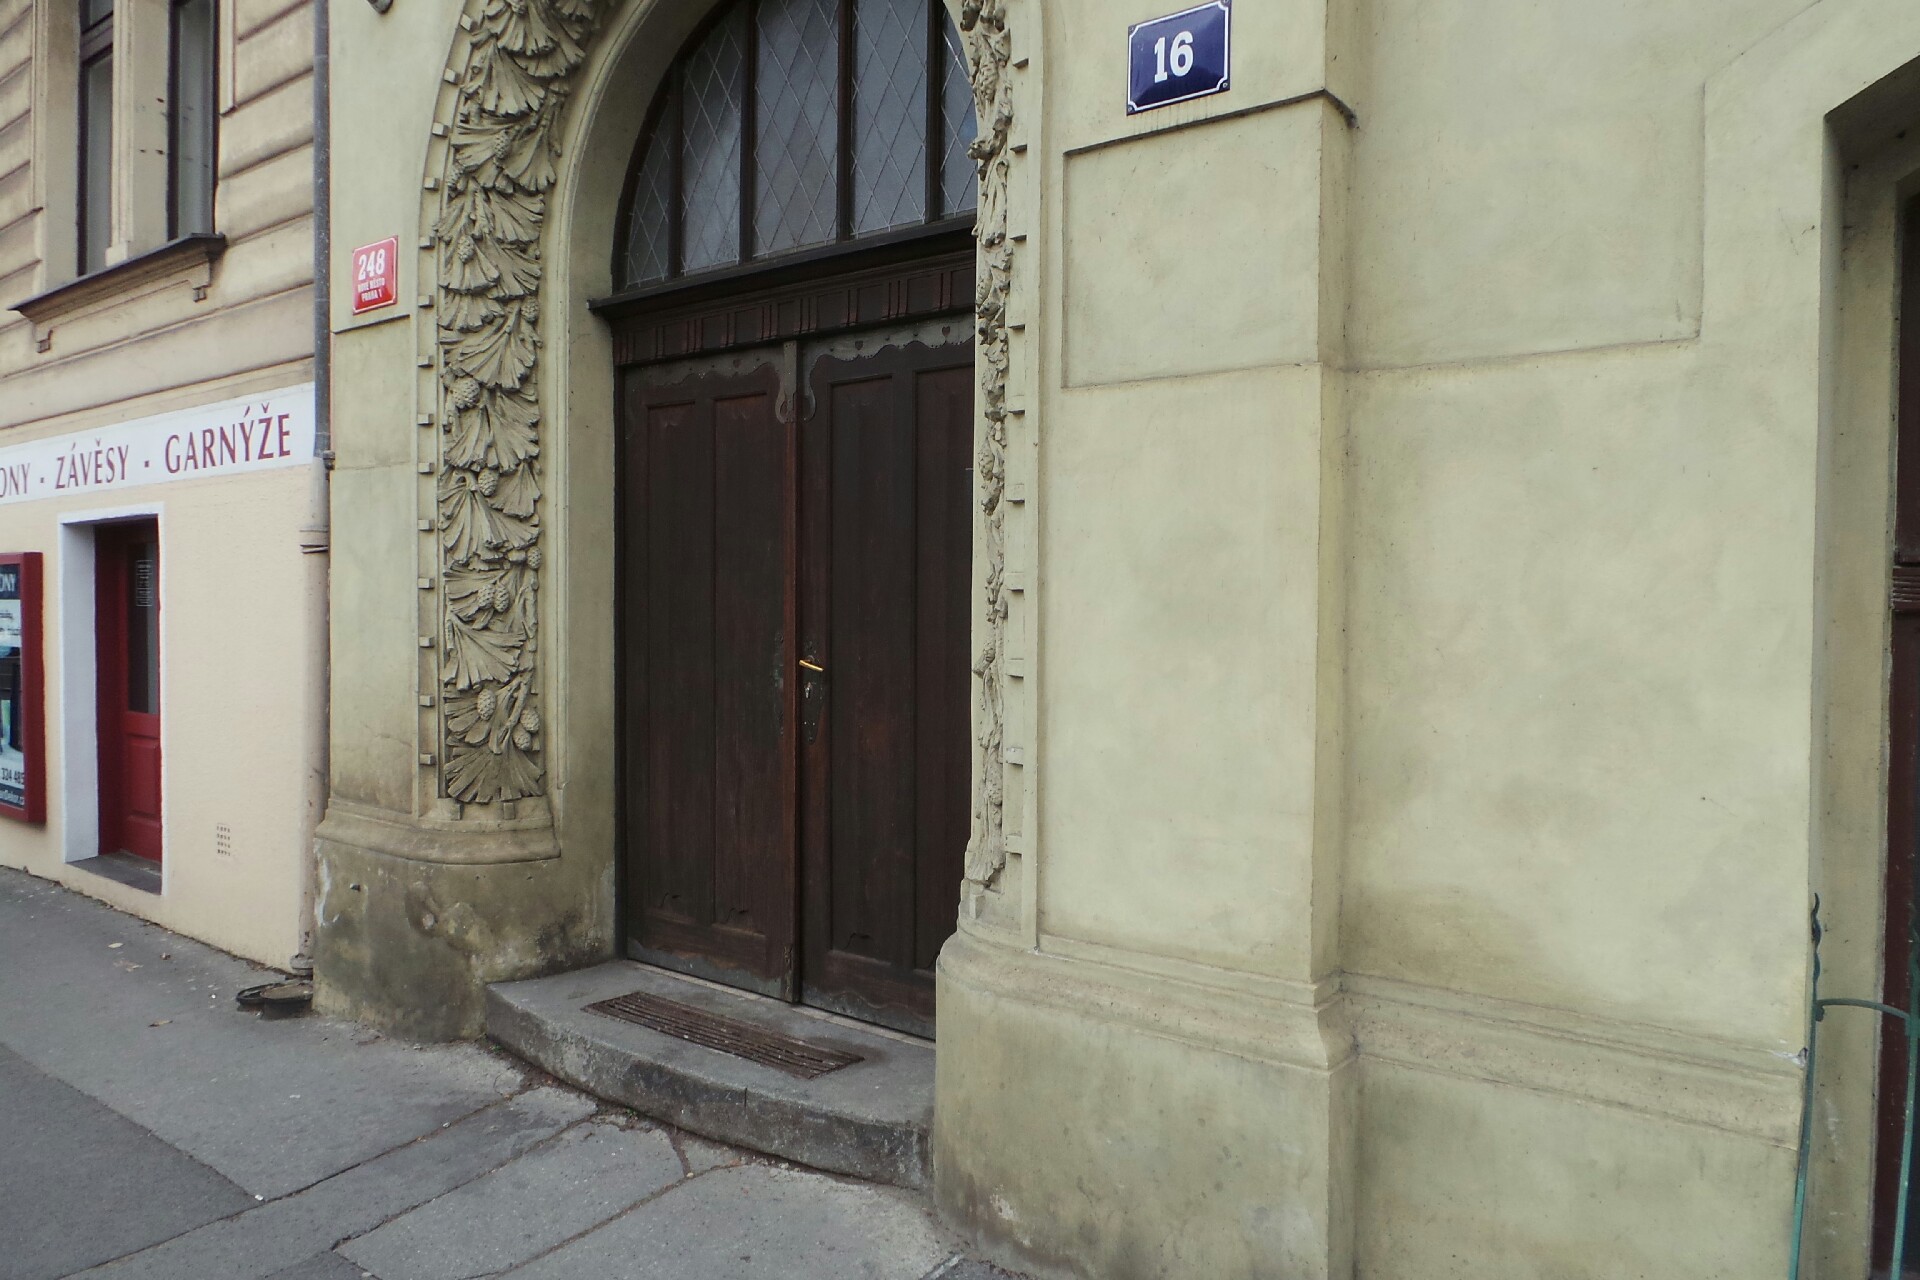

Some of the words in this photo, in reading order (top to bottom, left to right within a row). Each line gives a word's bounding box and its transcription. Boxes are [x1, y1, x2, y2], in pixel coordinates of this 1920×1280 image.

[1154, 30, 1194, 84] 16
[358, 248, 386, 281] 248
[361, 290, 378, 302] PRAHA
[55, 437, 129, 490] ZÁVĚSY
[165, 402, 291, 474] GARNÝŽE
